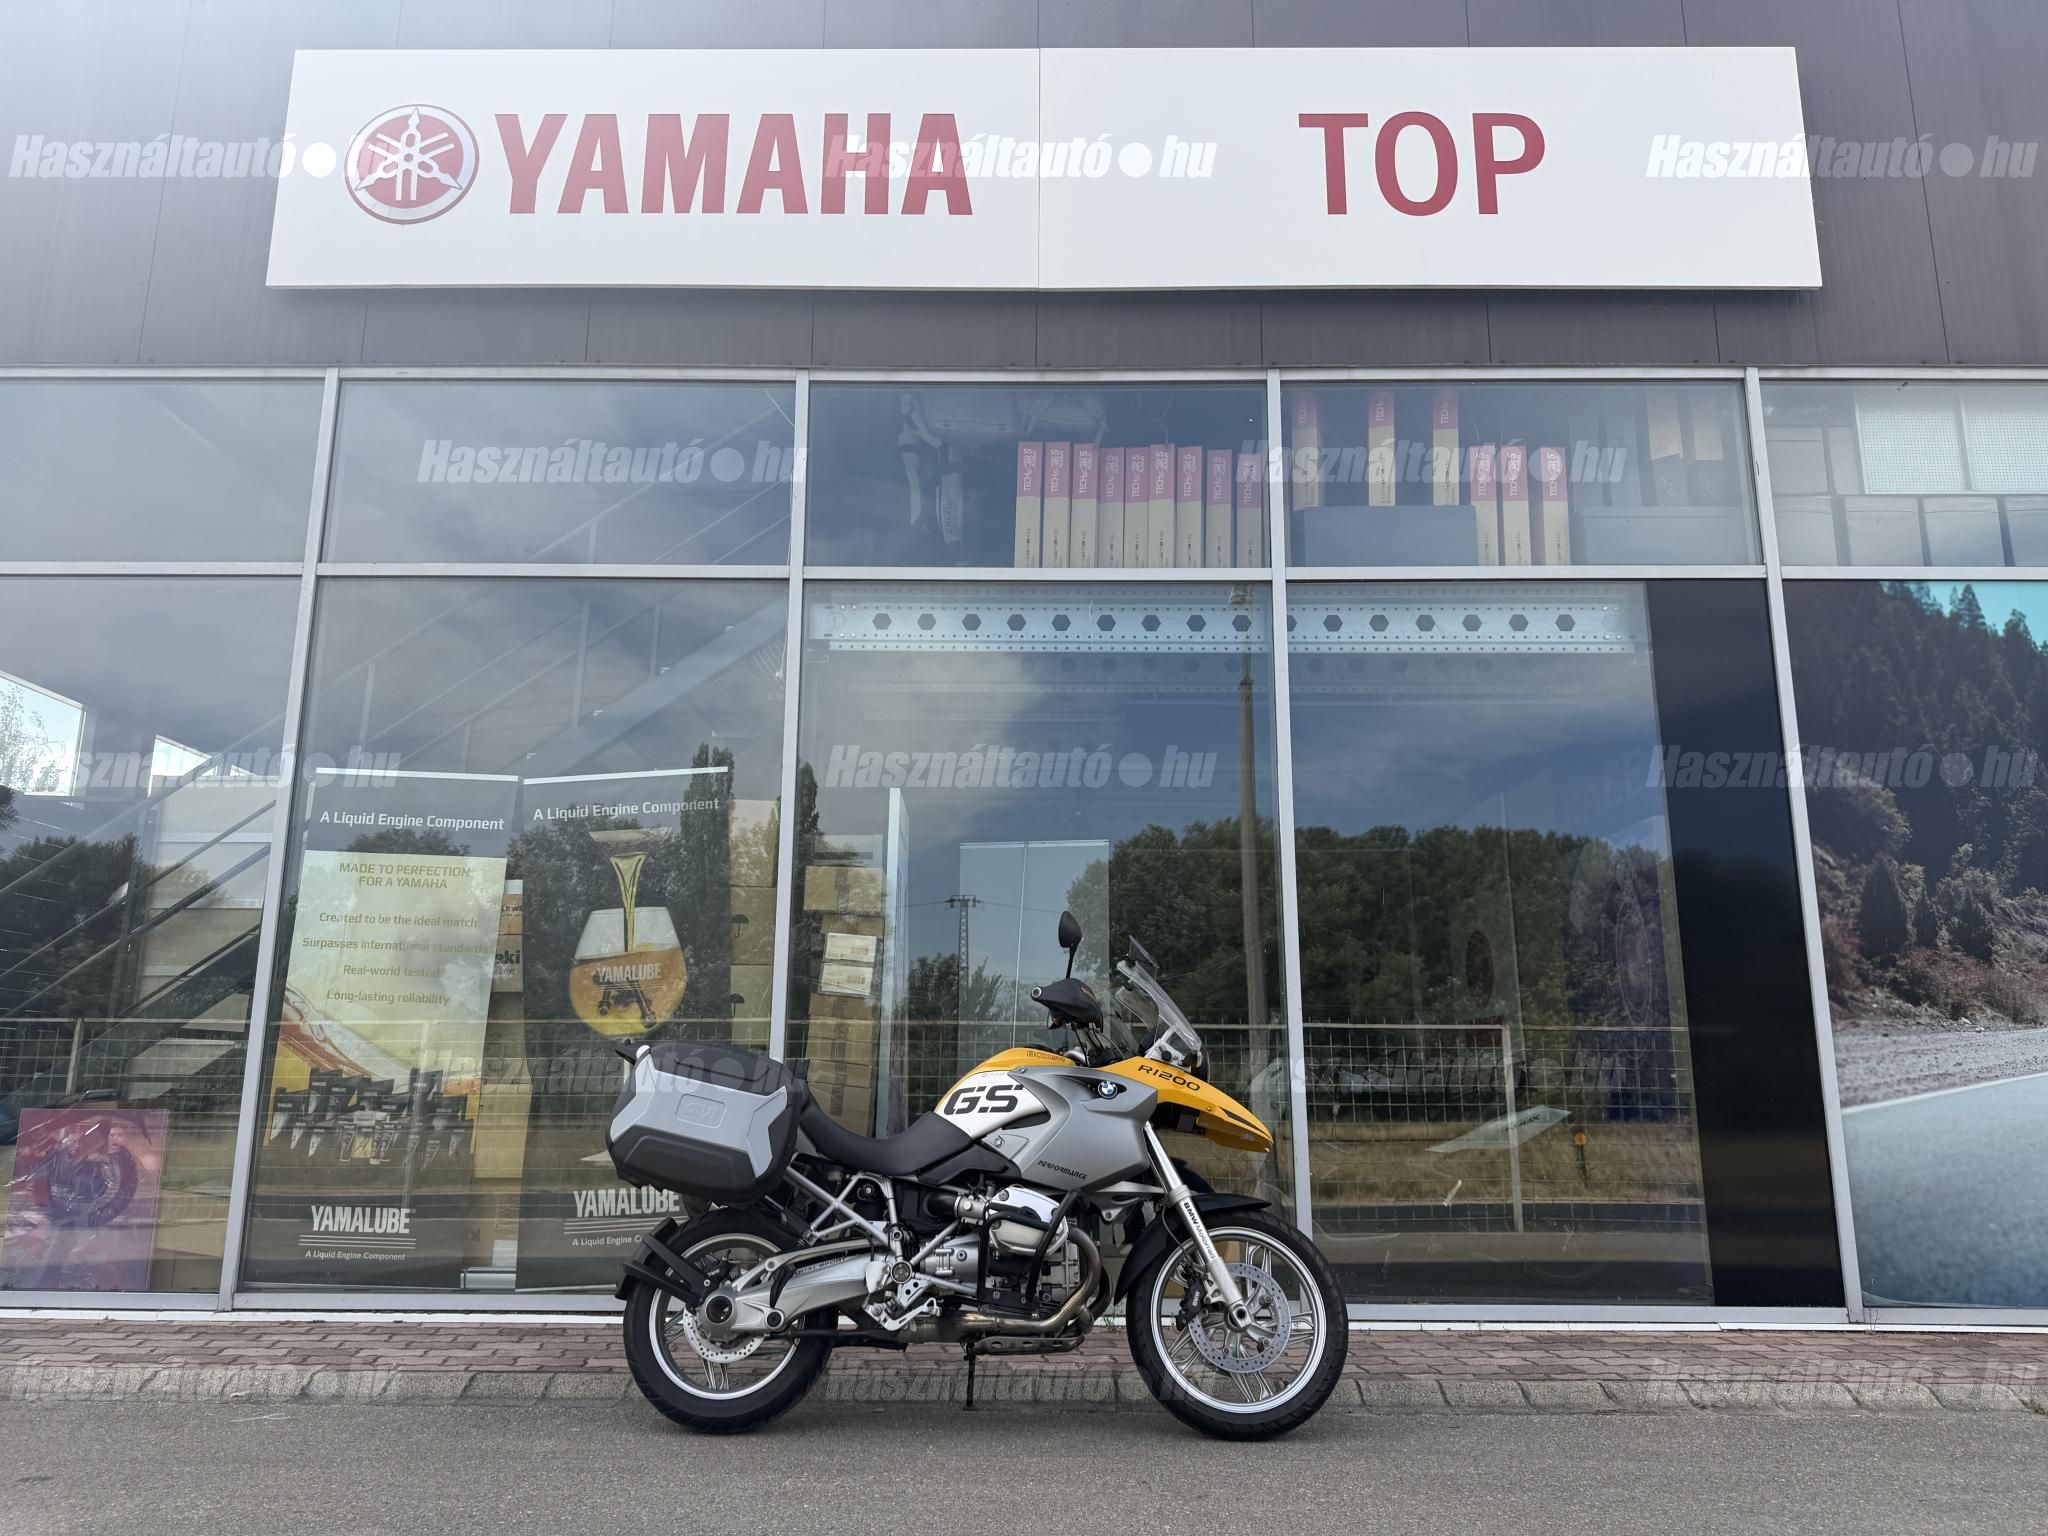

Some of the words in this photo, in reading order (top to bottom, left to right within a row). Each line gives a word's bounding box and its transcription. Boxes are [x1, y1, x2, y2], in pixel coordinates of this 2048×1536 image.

[494, 113, 973, 215] YAMAHA
[1298, 111, 1546, 217] TOP
[533, 808, 544, 820] A
[547, 805, 589, 822] Liquid
[592, 802, 638, 819] Engine
[642, 798, 719, 815] Component
[320, 811, 330, 824] A
[333, 811, 374, 828] Liquid
[378, 813, 423, 830] Engine
[426, 815, 505, 831] Component
[339, 862, 375, 874] MADE
[378, 863, 393, 874] TO
[396, 864, 471, 878] PERFECTION
[358, 877, 382, 887] FOR
[385, 878, 393, 887] A
[396, 878, 448, 889] YAMAHA
[320, 911, 362, 924] Created
[365, 913, 376, 924] to
[378, 912, 391, 925] be
[393, 912, 412, 926] the
[414, 914, 441, 927] ideal
[443, 916, 478, 928] match
[302, 937, 358, 951] Surpasses
[360, 939, 430, 952] international
[432, 942, 489, 954] standards
[343, 964, 400, 977] Real-world
[597, 962, 662, 983] YAMALUBE
[326, 990, 395, 1005] Long-lasting
[397, 991, 450, 1007] reliability
[1137, 1063, 1202, 1093] R1200
[943, 1084, 1024, 1116] GS
[1037, 1159, 1088, 1180] PERFORMANCE
[573, 1185, 681, 1218] YAMALUBE
[310, 1205, 411, 1234] YAMALUBE
[1183, 1202, 1199, 1225] BMW
[1195, 1224, 1216, 1260] Motorrad
[572, 1238, 579, 1246] A
[580, 1236, 605, 1248] Liquid
[606, 1236, 633, 1246] Engine
[305, 1250, 312, 1258] A
[313, 1250, 336, 1259] Liquid
[337, 1251, 362, 1260] Engine
[363, 1251, 406, 1261] Component
